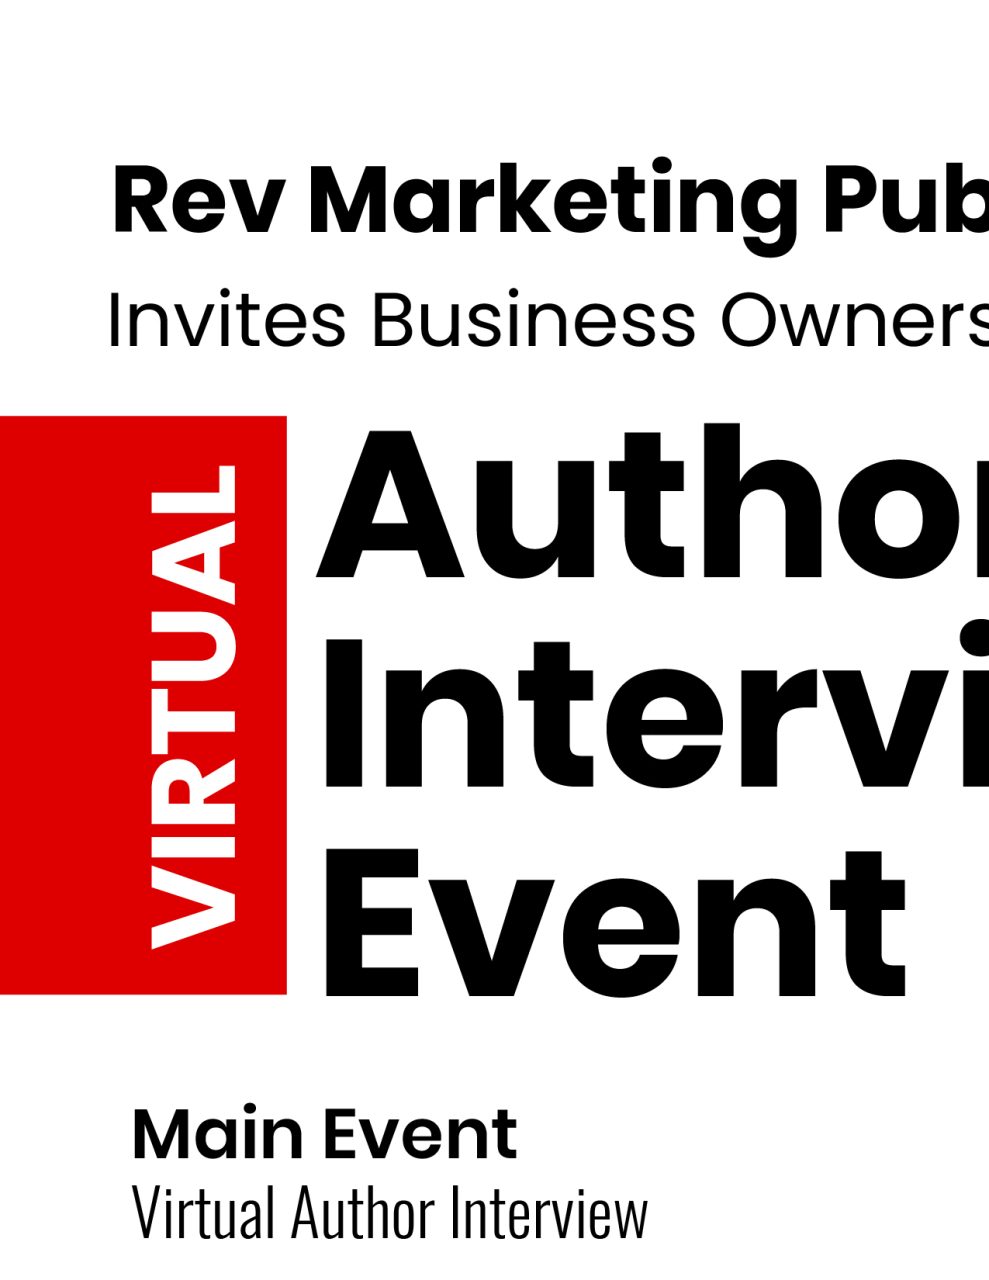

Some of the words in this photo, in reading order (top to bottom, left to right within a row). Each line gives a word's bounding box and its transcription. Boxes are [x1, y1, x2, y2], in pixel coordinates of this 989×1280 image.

[115, 165, 286, 233] Rev
[311, 156, 797, 258] Marketing
[111, 288, 345, 347] Invites
[375, 288, 695, 347] Business
[152, 466, 236, 949] VIRTUAL
[326, 849, 905, 998] Event
[135, 1103, 301, 1159] Main
[325, 1109, 516, 1159] Event
[132, 1185, 273, 1239] Virtual
[291, 1185, 435, 1239] Author
[453, 1185, 648, 1239] Interview
